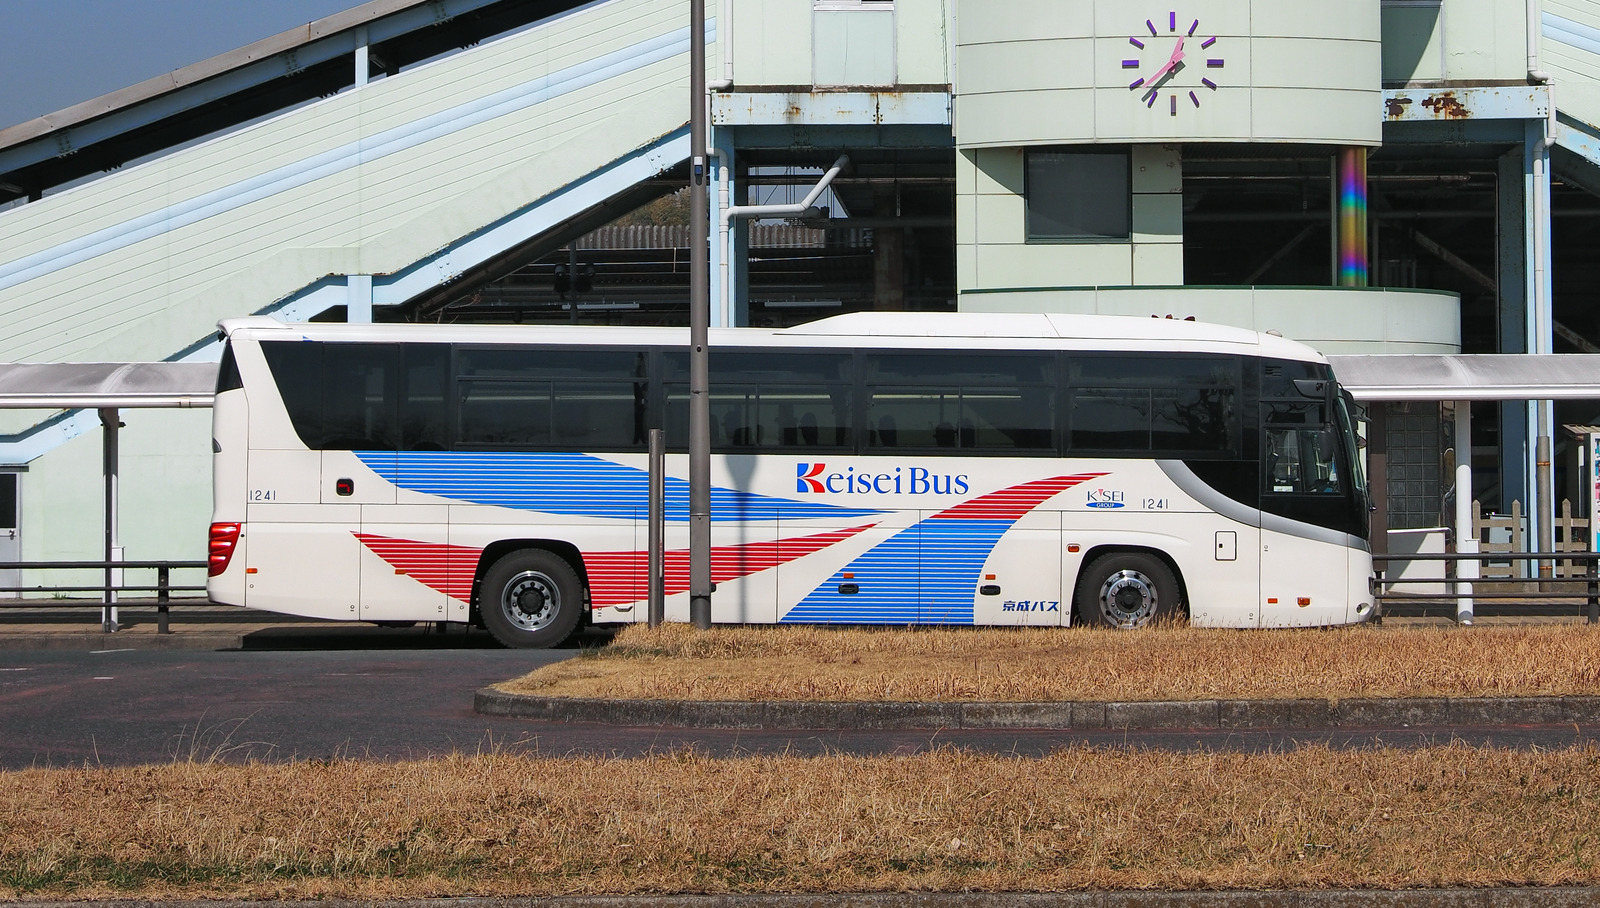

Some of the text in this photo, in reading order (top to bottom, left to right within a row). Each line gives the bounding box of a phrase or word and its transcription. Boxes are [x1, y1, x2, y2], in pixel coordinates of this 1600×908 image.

[796, 463, 969, 495] Keisei Bus
[249, 489, 276, 501] 1241
[1142, 498, 1169, 509] 1241
[1002, 600, 1059, 612] 京成バス
